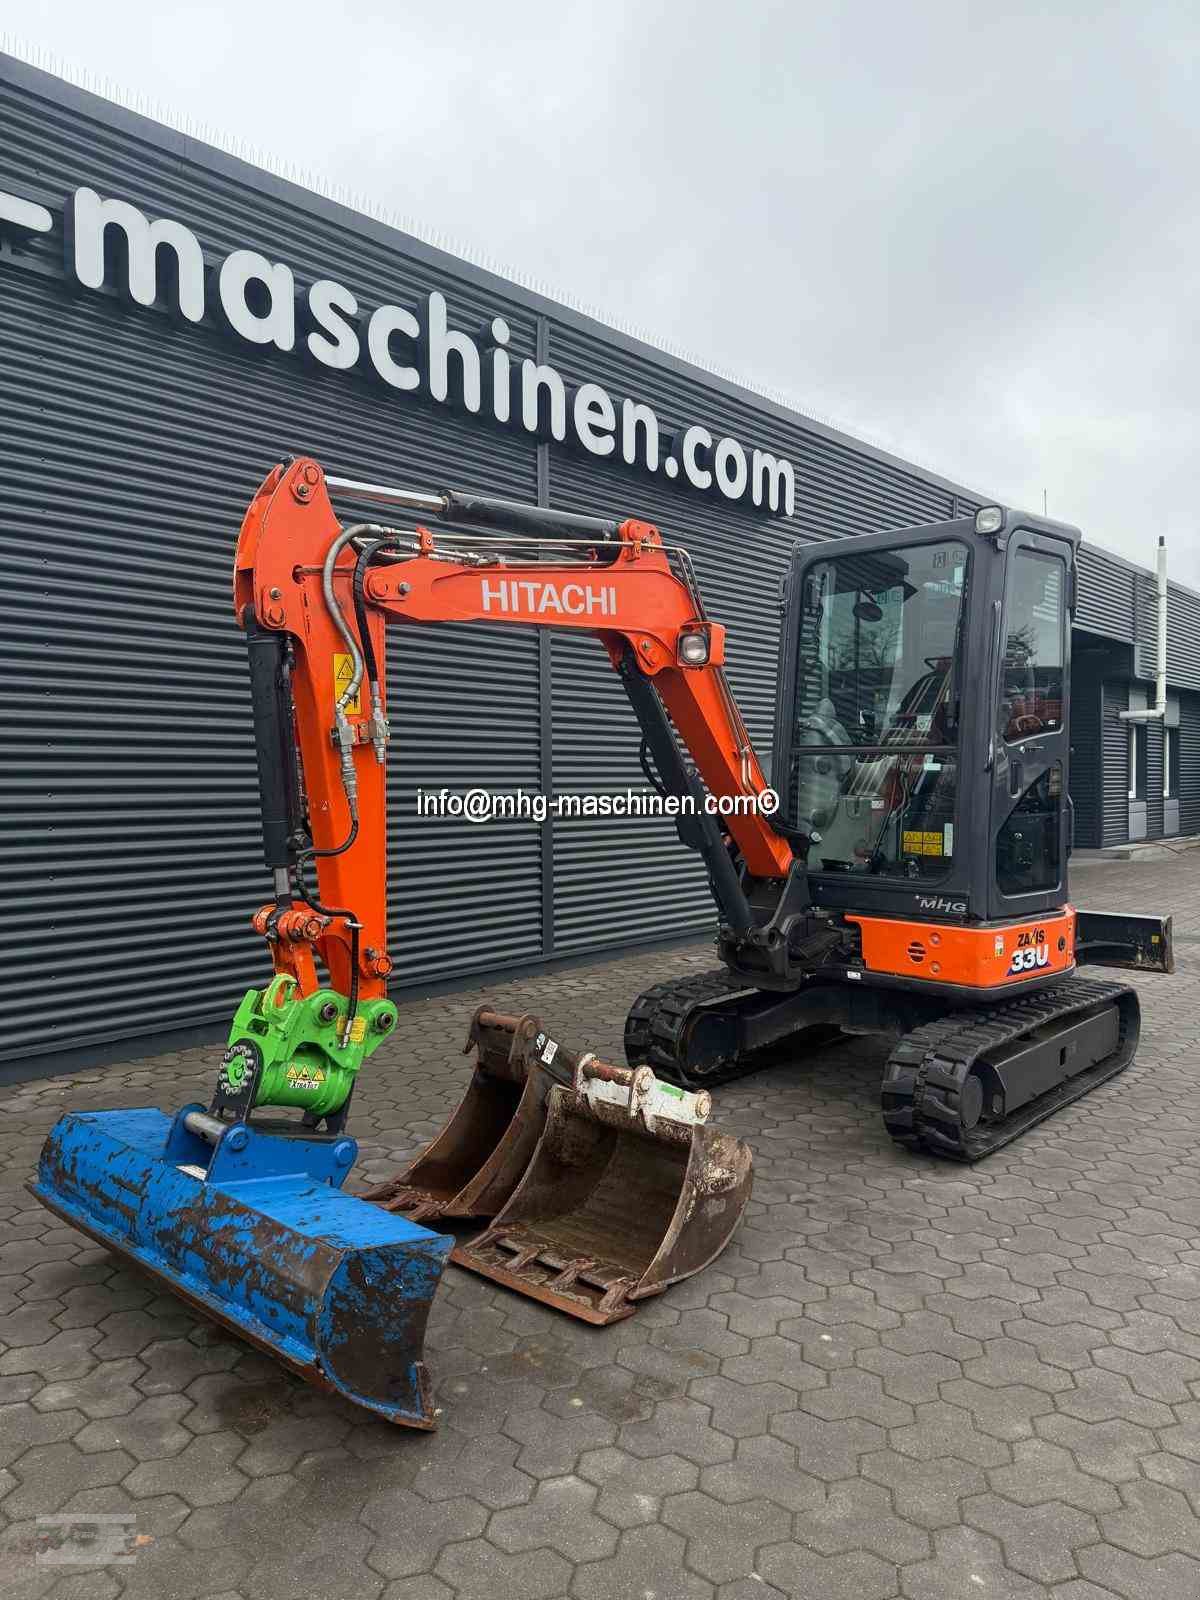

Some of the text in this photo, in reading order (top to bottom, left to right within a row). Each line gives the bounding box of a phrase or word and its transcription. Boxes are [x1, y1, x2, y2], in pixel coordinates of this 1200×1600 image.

[481, 579, 616, 615] HITACHI
[920, 898, 967, 912] MHG
[1011, 944, 1049, 972] 33U
